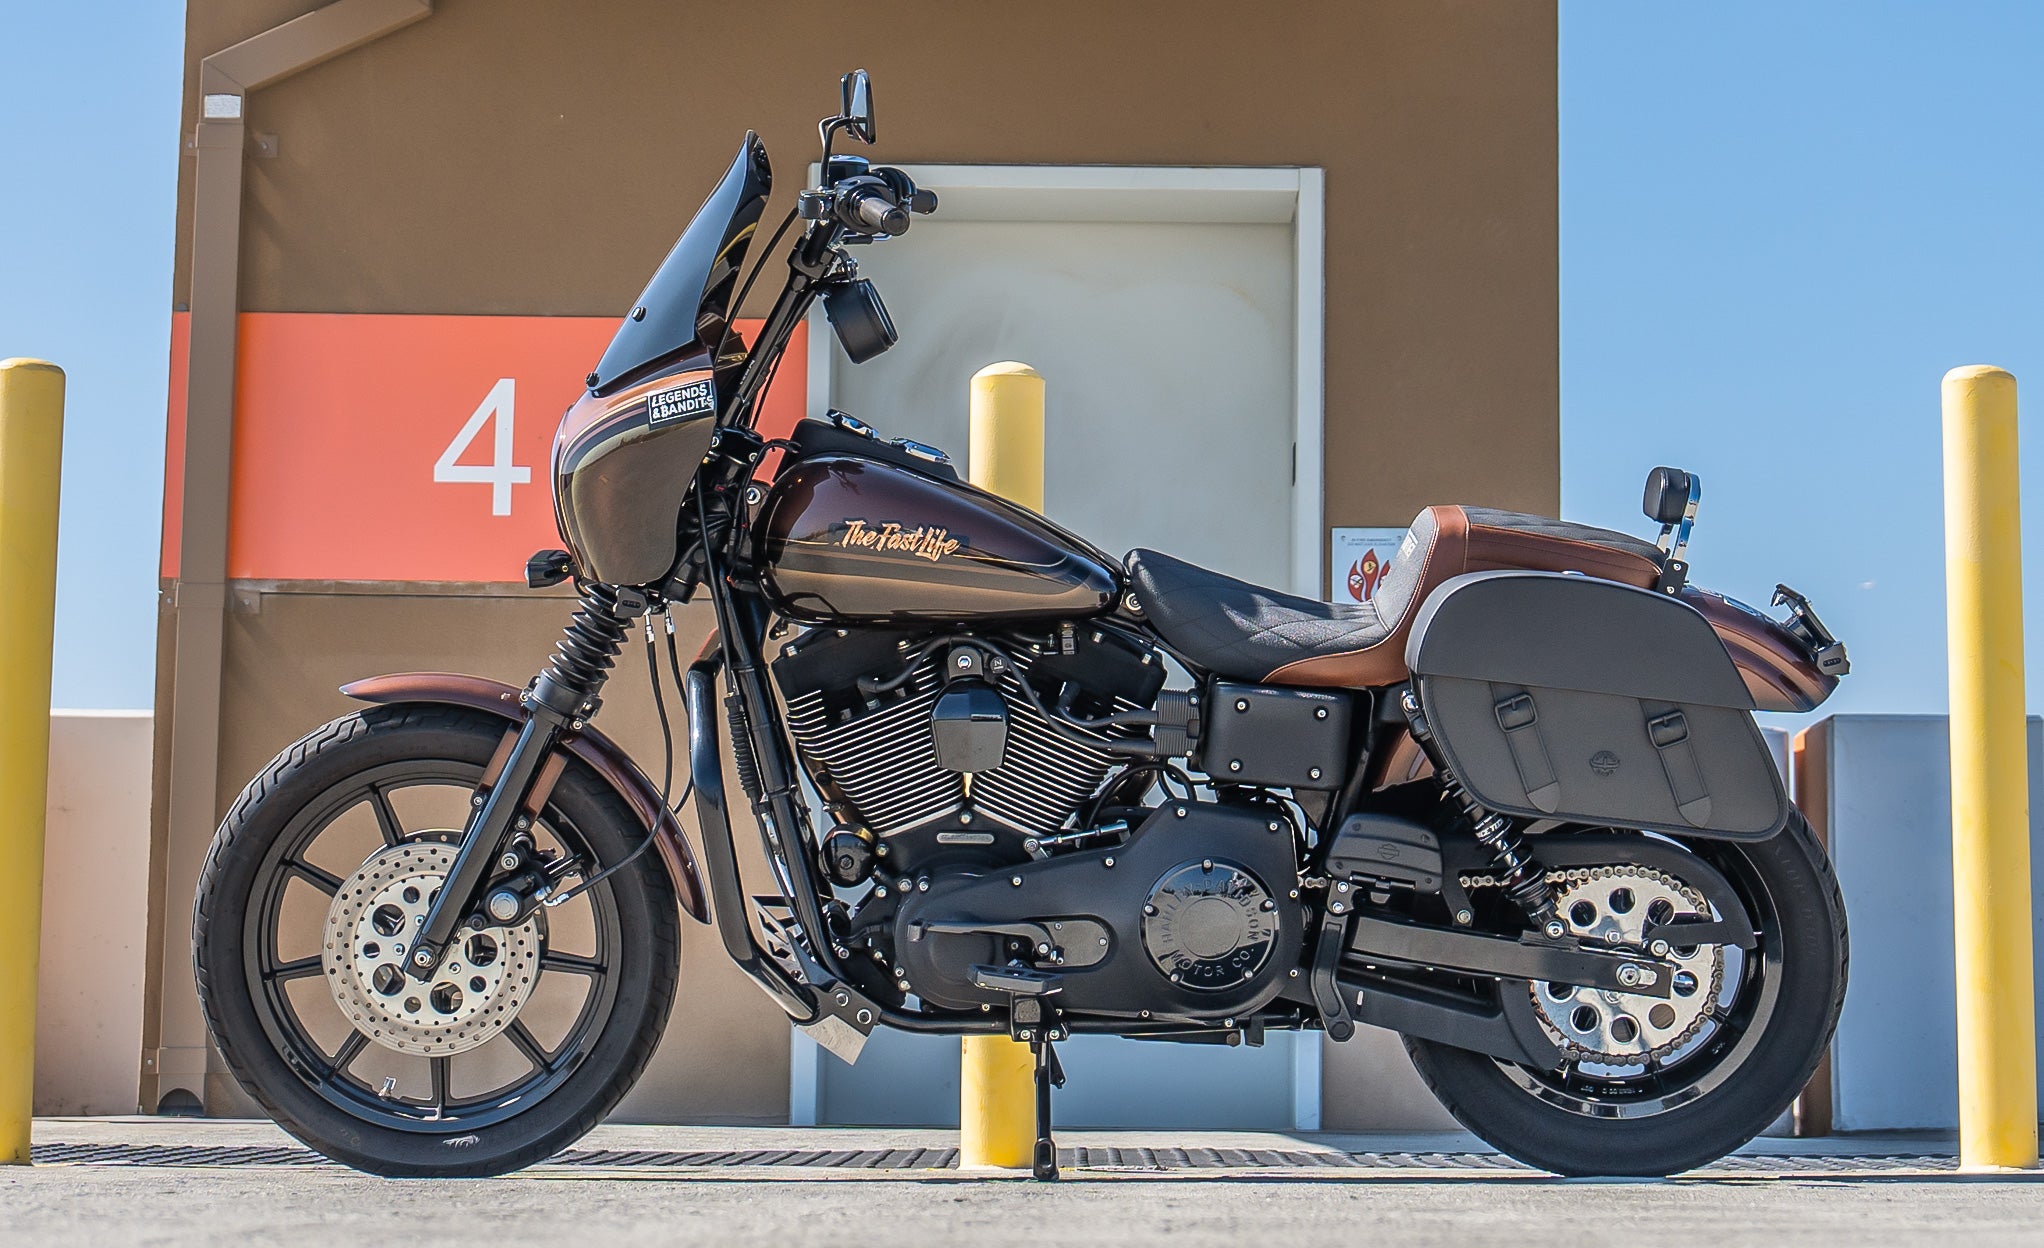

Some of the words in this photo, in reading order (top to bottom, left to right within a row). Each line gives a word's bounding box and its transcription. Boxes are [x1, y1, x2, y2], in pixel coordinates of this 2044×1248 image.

[651, 383, 708, 408] LEGENDS
[433, 377, 532, 517] 4
[841, 520, 880, 549] The
[876, 523, 923, 552] Fast
[915, 526, 961, 562] Life
[1171, 951, 1226, 978] MOTOR
